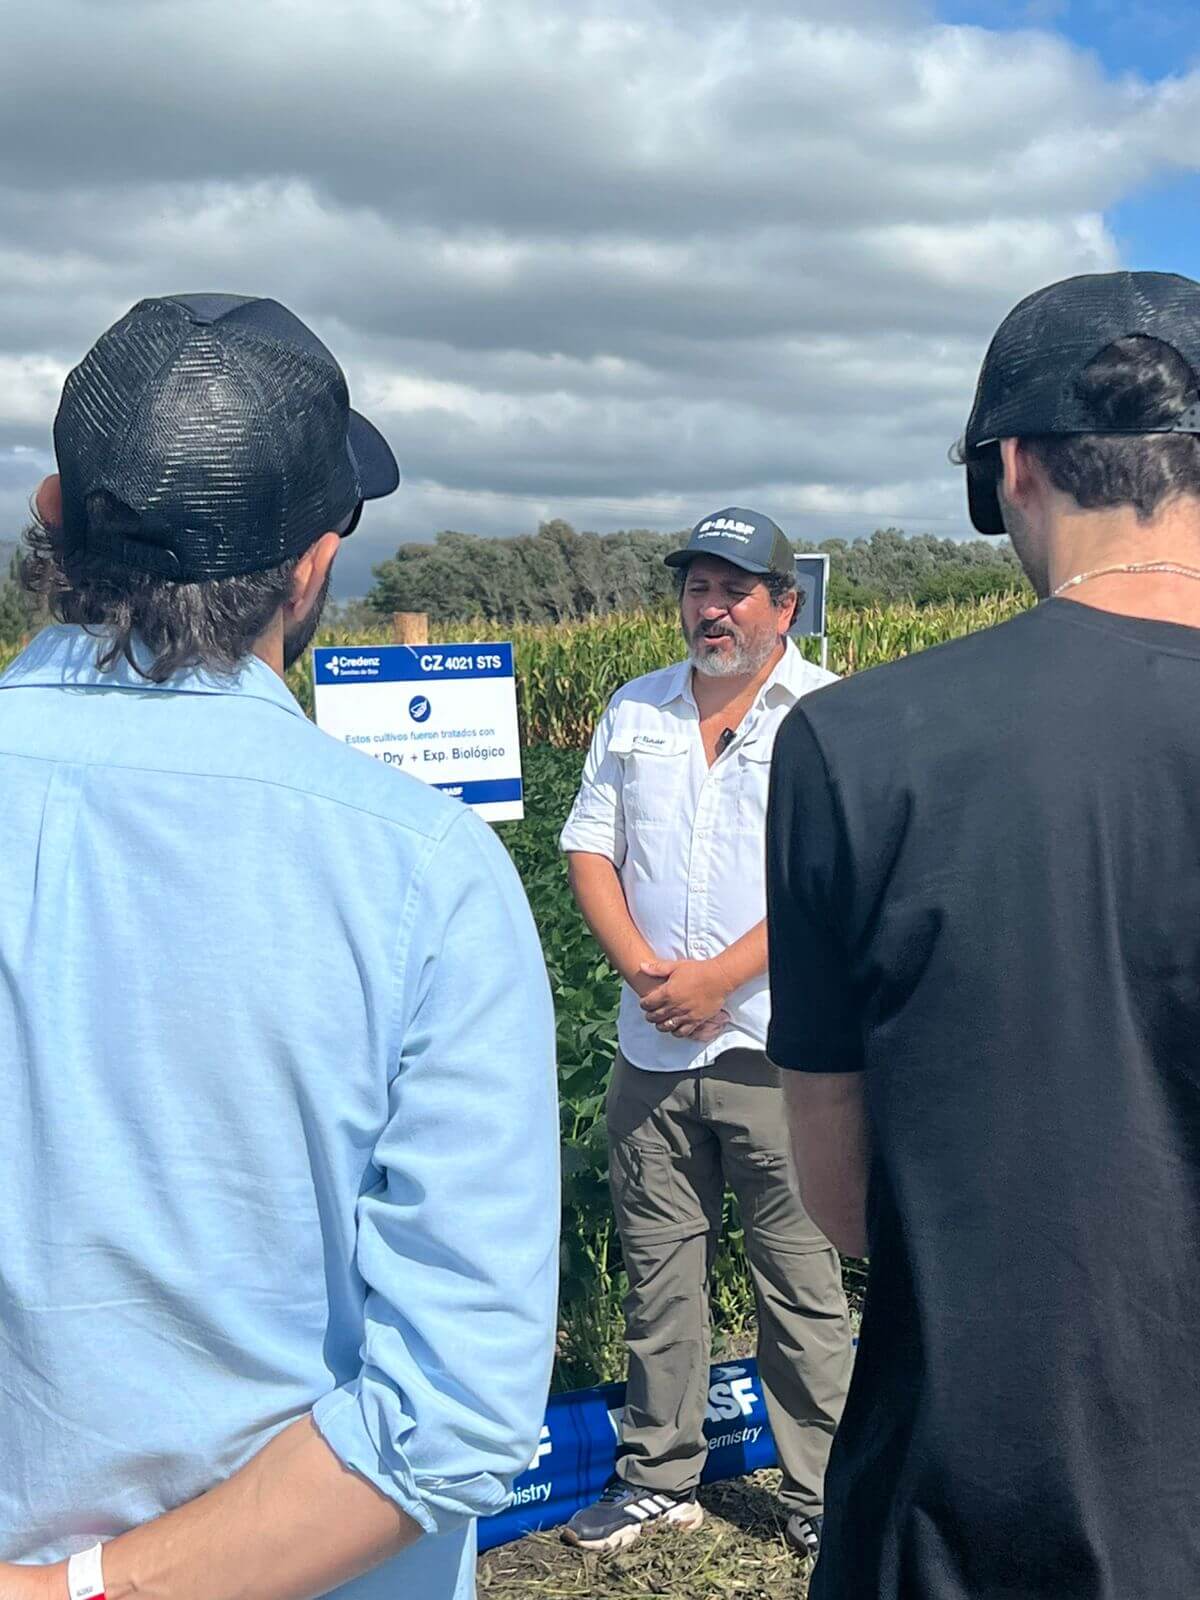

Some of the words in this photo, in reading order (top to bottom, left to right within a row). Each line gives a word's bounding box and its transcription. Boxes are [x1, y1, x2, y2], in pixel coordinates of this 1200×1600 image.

[340, 656, 380, 667] Credenz
[420, 654, 444, 671] CZ
[444, 656, 473, 670] 4021
[476, 655, 502, 669] STS
[345, 734, 371, 744] Estos
[373, 732, 408, 743] cultivos
[410, 731, 439, 741] fueron
[440, 728, 477, 738] tratados
[479, 728, 496, 736] con
[383, 752, 404, 766] Dry
[423, 749, 449, 763] Exp.
[452, 745, 505, 760] Biológico
[708, 1426, 763, 1450] emistry
